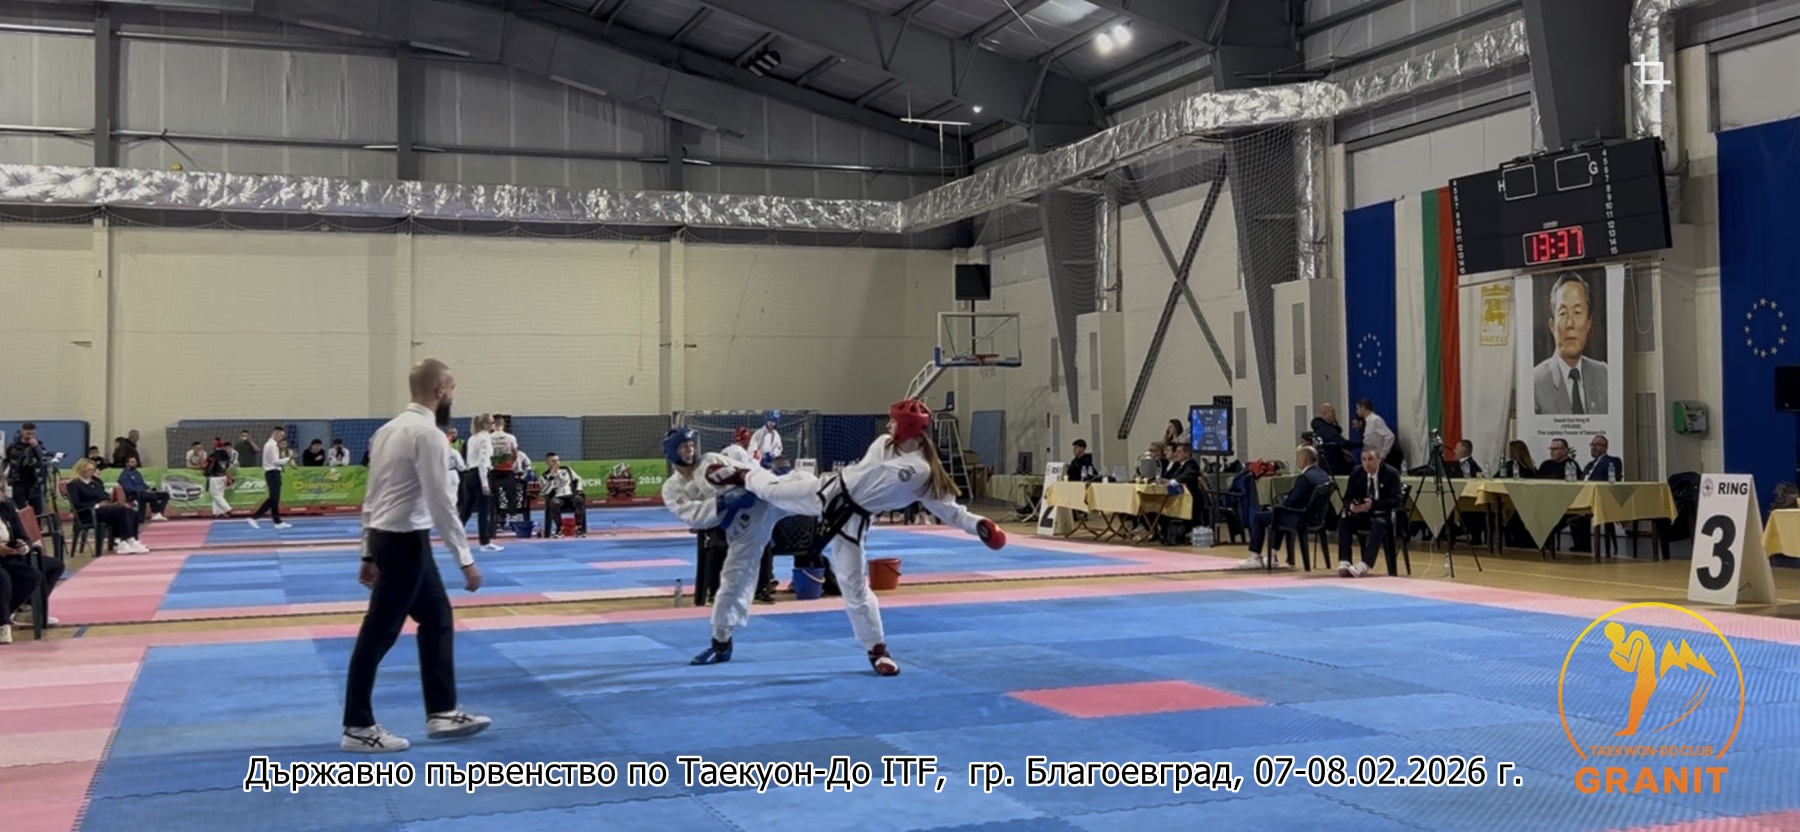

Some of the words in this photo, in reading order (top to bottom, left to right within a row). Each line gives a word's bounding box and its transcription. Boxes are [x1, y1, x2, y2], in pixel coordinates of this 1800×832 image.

[1603, 157, 1608, 165] 5
[1588, 161, 1598, 174] G
[1603, 166, 1609, 174] 6
[1604, 174, 1609, 182] 7
[1498, 180, 1506, 192] H
[1606, 184, 1611, 193] 8
[1605, 202, 1613, 210] 10
[1532, 228, 1583, 262] 13:37
[638, 476, 662, 484] 2019
[1718, 482, 1748, 495] RING
[1696, 514, 1736, 590] 3
